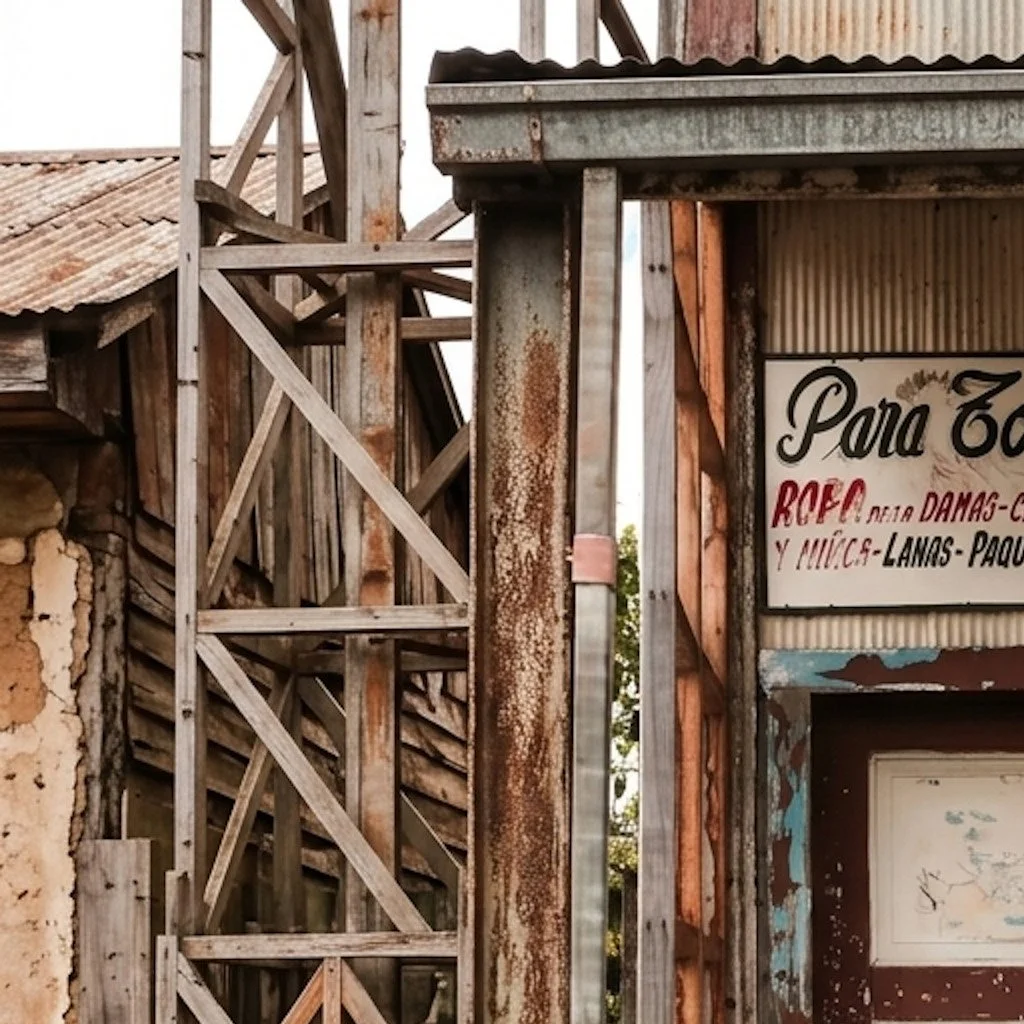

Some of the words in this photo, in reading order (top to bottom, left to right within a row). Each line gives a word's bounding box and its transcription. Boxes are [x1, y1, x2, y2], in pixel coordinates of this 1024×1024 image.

[776, 366, 931, 464] Para
[771, 478, 867, 528] ROPA
[775, 538, 790, 571] Y
